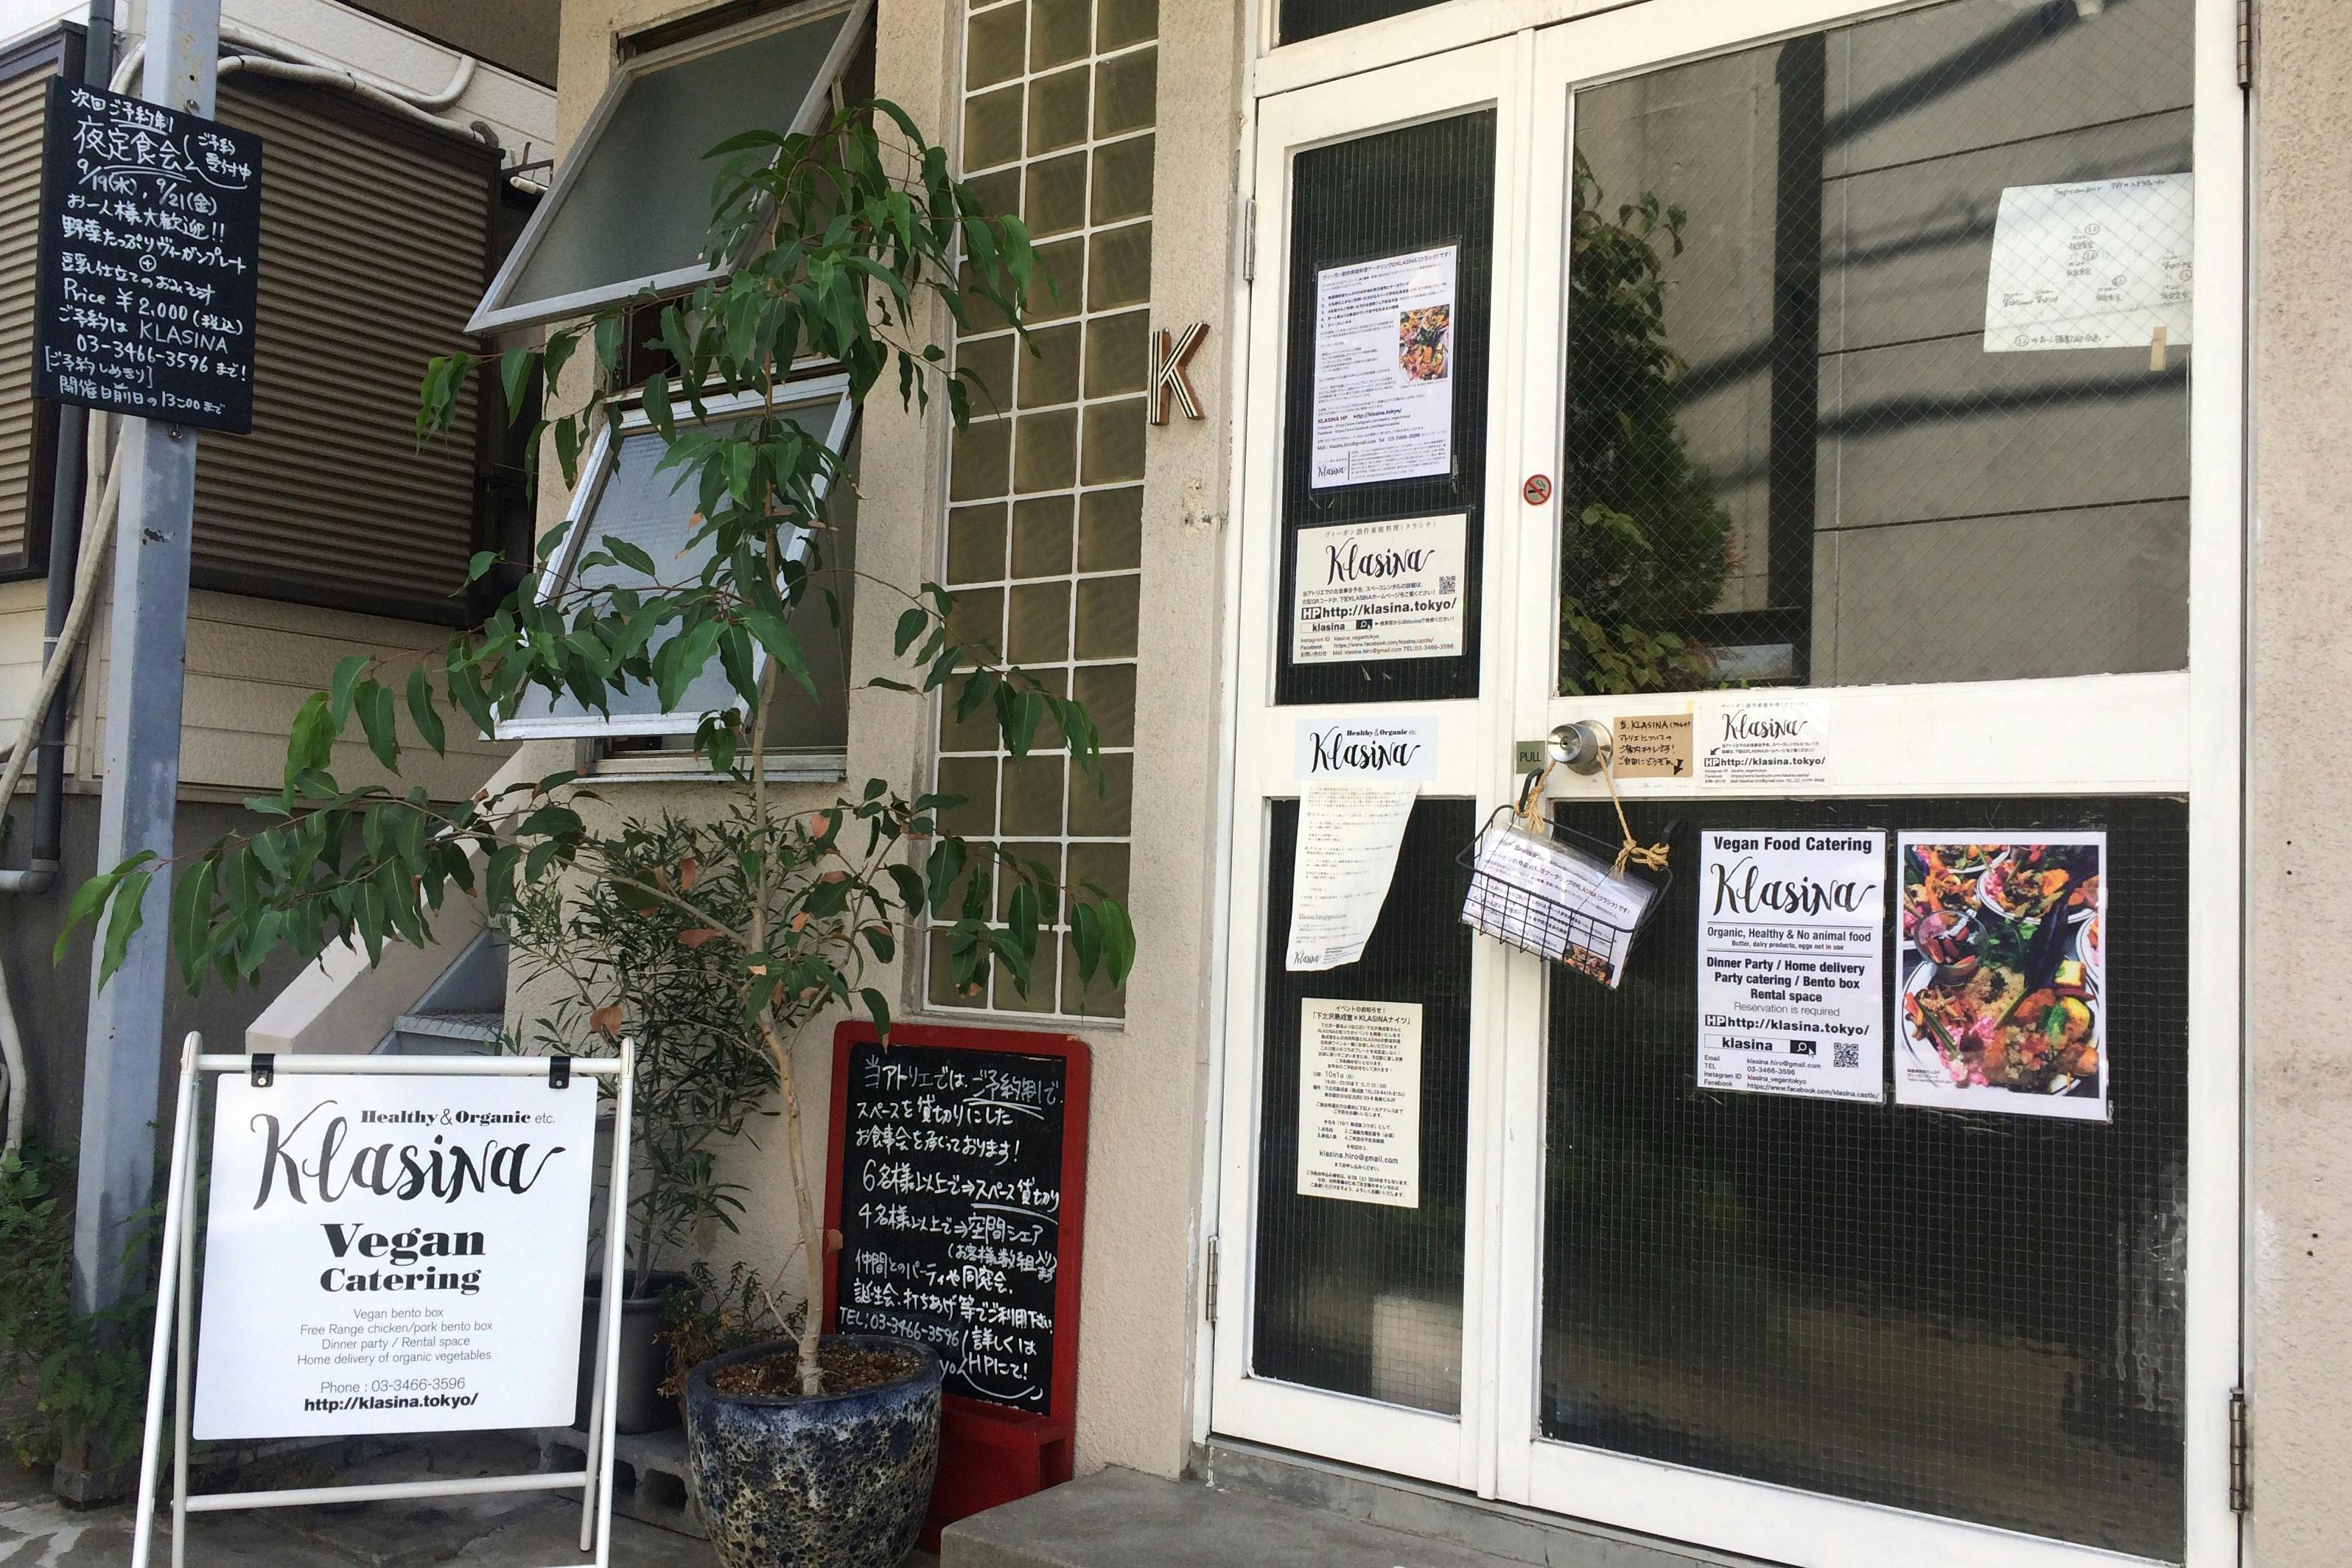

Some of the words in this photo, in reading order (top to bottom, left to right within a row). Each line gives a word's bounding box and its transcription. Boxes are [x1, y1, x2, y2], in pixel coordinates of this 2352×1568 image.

[74, 116, 183, 170] 夜定食会
[197, 134, 236, 154] ご予約
[206, 156, 251, 183] 受付中
[64, 278, 105, 304] Price
[140, 319, 228, 354] KLASINA
[77, 334, 208, 373] 03-3466-3596
[1149, 322, 1211, 426] K
[1326, 538, 1435, 585] Klasina
[1323, 598, 1457, 618] http://klasina.tokyo/
[1312, 623, 1345, 631] klasina
[1722, 709, 1808, 741] Klasina
[1310, 727, 1421, 773] Klasina
[1520, 752, 1541, 762] PULL
[1721, 757, 1825, 767] http://klasina.tokyo/
[1714, 836, 1759, 853] Vegan
[1764, 837, 1800, 850] Food
[1806, 837, 1872, 854] Catering
[1710, 856, 1877, 916] Klasina
[1707, 927, 1746, 939] Organic,
[1749, 928, 1783, 941] Healthy
[1787, 930, 1794, 939] &
[1797, 930, 1810, 939] No
[1813, 931, 1846, 941] animal
[1849, 932, 1871, 942] food
[1707, 957, 1742, 968] Dinner
[1745, 959, 1774, 972] Party
[1777, 959, 1781, 970] /
[1785, 960, 1816, 972] Home
[1819, 962, 1865, 976] delivery
[1715, 972, 1743, 984] Party
[1746, 974, 1791, 987] catering
[1795, 976, 1799, 987] /
[1803, 976, 1835, 988] Bento
[1839, 978, 1860, 989] box
[1751, 989, 1785, 1001] Rental
[1789, 993, 1822, 1003] space
[1735, 1002, 1788, 1013] Reservation
[1791, 1006, 1798, 1014] is
[1802, 1007, 1840, 1017] required
[1705, 1015, 1726, 1027] HP
[1728, 1016, 1869, 1036] http://klasina.tokyo/
[1722, 1037, 1773, 1051] klasina
[360, 1110, 439, 1126] Healthy
[440, 1109, 452, 1125] &
[455, 1110, 531, 1125] Organic
[535, 1112, 556, 1124] etc.
[251, 1100, 566, 1210] Klasina
[1320, 1149, 1398, 1164] klasina.hiro@gmail.com
[321, 1223, 486, 1267] Vegan
[320, 1267, 481, 1295] Catering
[354, 1309, 387, 1320] Vegan
[391, 1308, 421, 1319] bento
[425, 1308, 444, 1317] box
[301, 1324, 325, 1336] Free
[329, 1324, 364, 1337] Range
[368, 1321, 437, 1335] chicken/pork
[441, 1320, 470, 1332] bento
[474, 1320, 493, 1331] box
[322, 1338, 357, 1350] Dinner
[361, 1338, 388, 1351] party
[402, 1336, 435, 1348] Rental
[439, 1337, 470, 1348] space
[298, 1354, 330, 1366] Home
[334, 1353, 375, 1367] delivery
[378, 1353, 390, 1364] of
[393, 1351, 432, 1365] organic
[435, 1350, 491, 1363] vegetables
[321, 1381, 360, 1393] Phone
[371, 1377, 466, 1392] 03-3466-3596
[304, 1393, 478, 1413] http://klasina.tokyo/
